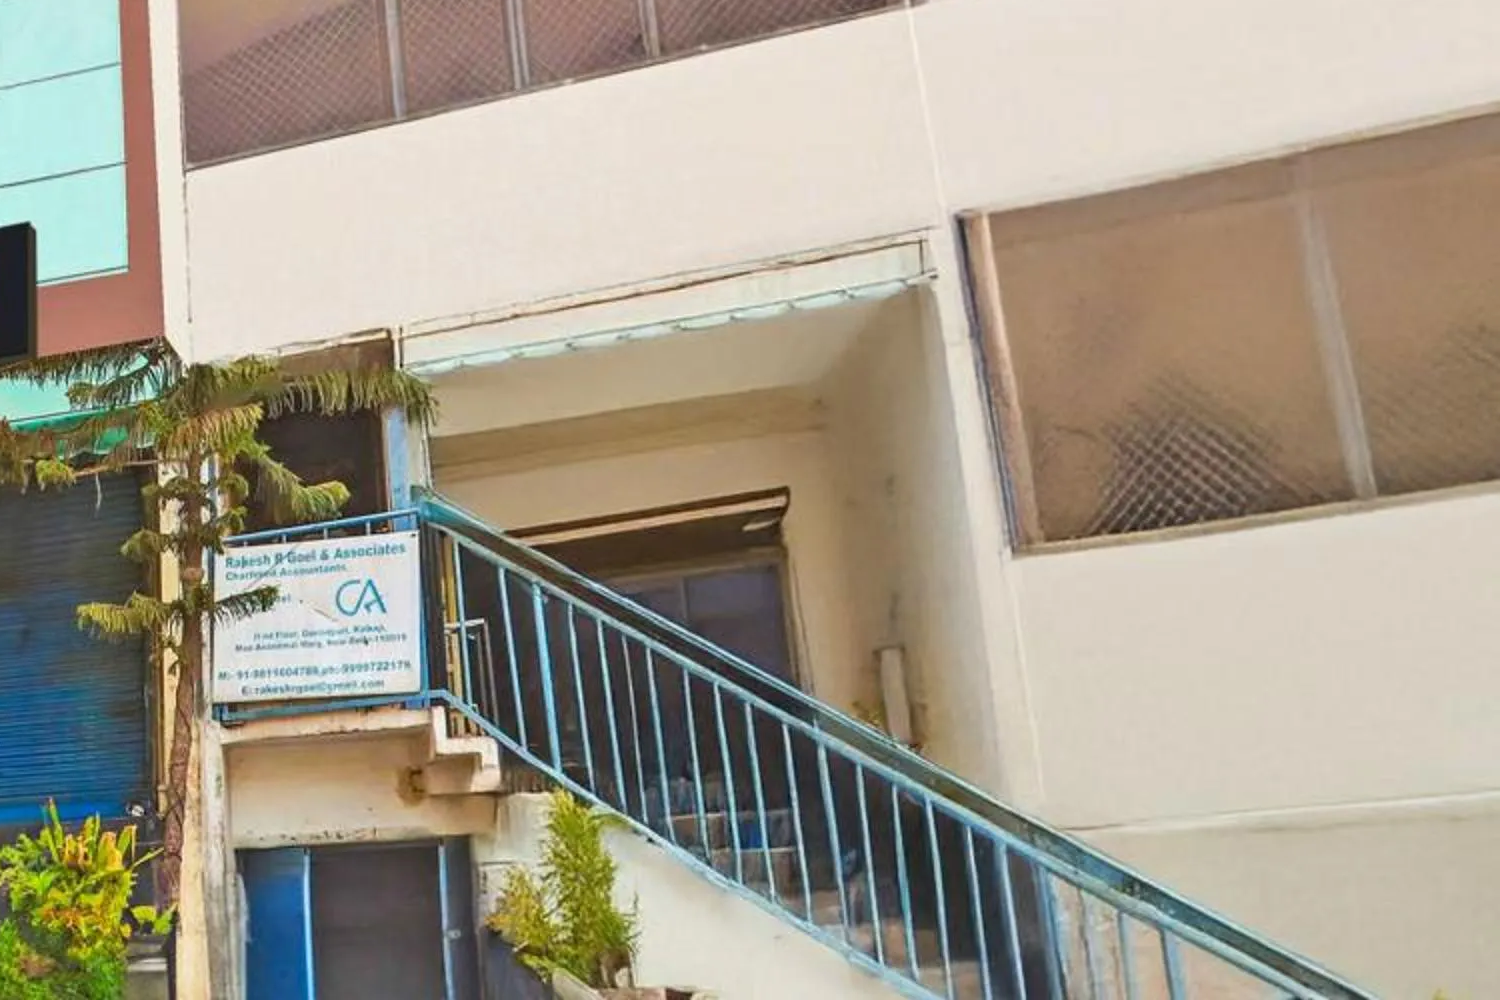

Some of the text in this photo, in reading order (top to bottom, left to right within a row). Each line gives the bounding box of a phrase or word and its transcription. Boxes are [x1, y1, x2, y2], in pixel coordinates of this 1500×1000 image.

[225, 553, 271, 569] Rakesh
[287, 549, 317, 564] Goel
[320, 548, 329, 561] &
[334, 542, 406, 559] Associates
[226, 564, 347, 581] Chartered Accountants
